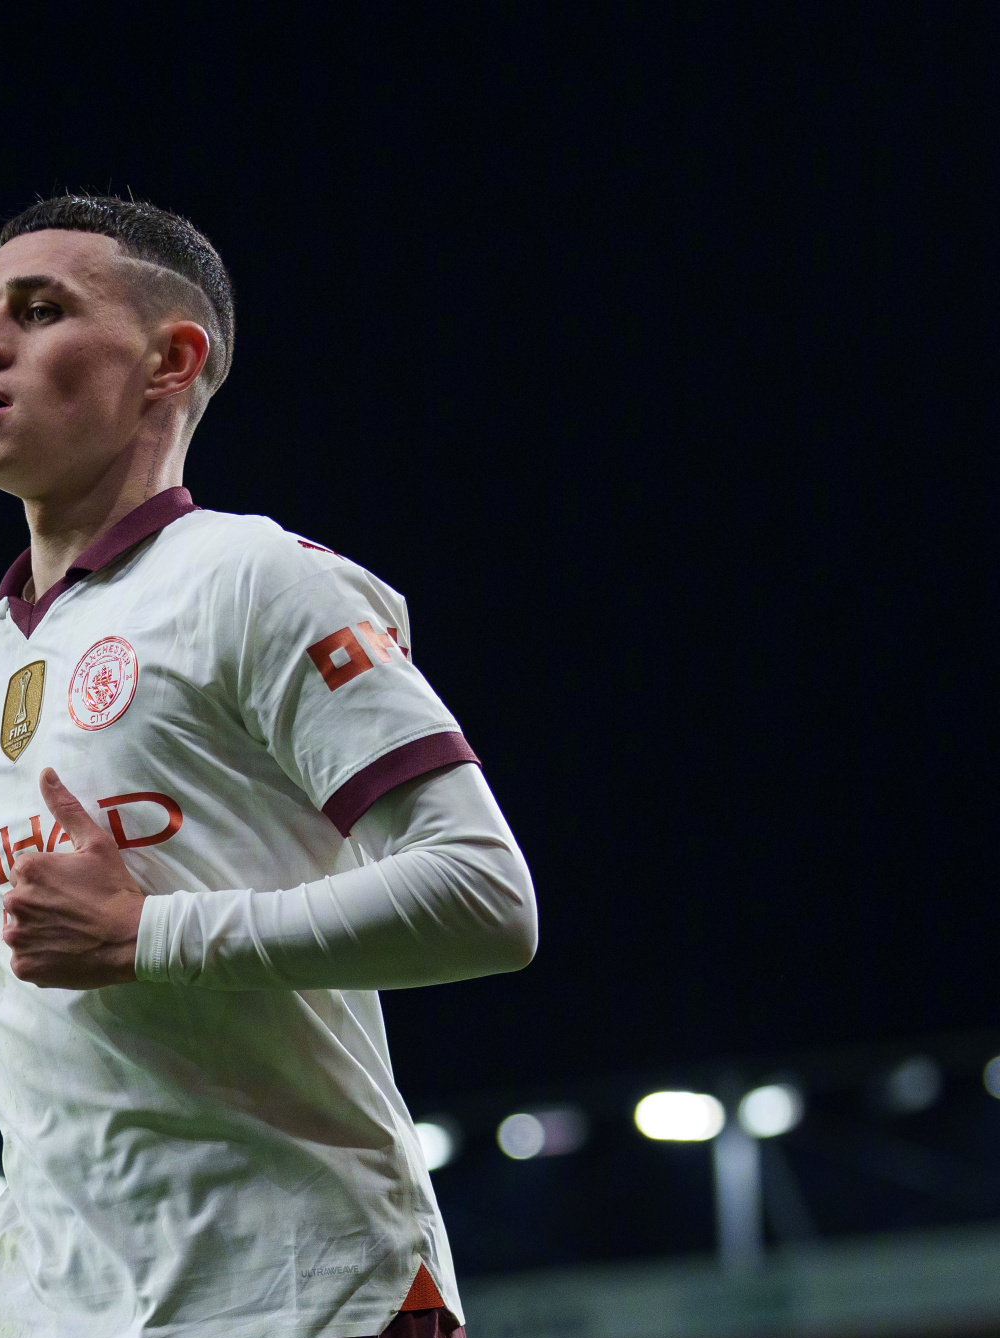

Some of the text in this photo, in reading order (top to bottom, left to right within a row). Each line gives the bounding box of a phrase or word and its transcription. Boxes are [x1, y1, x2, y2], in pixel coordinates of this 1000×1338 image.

[77, 644, 131, 679] MANCHESTER
[89, 711, 111, 724] CITY
[8, 721, 28, 741] FIFA
[301, 1264, 359, 1278] ULTRAWEAVE
